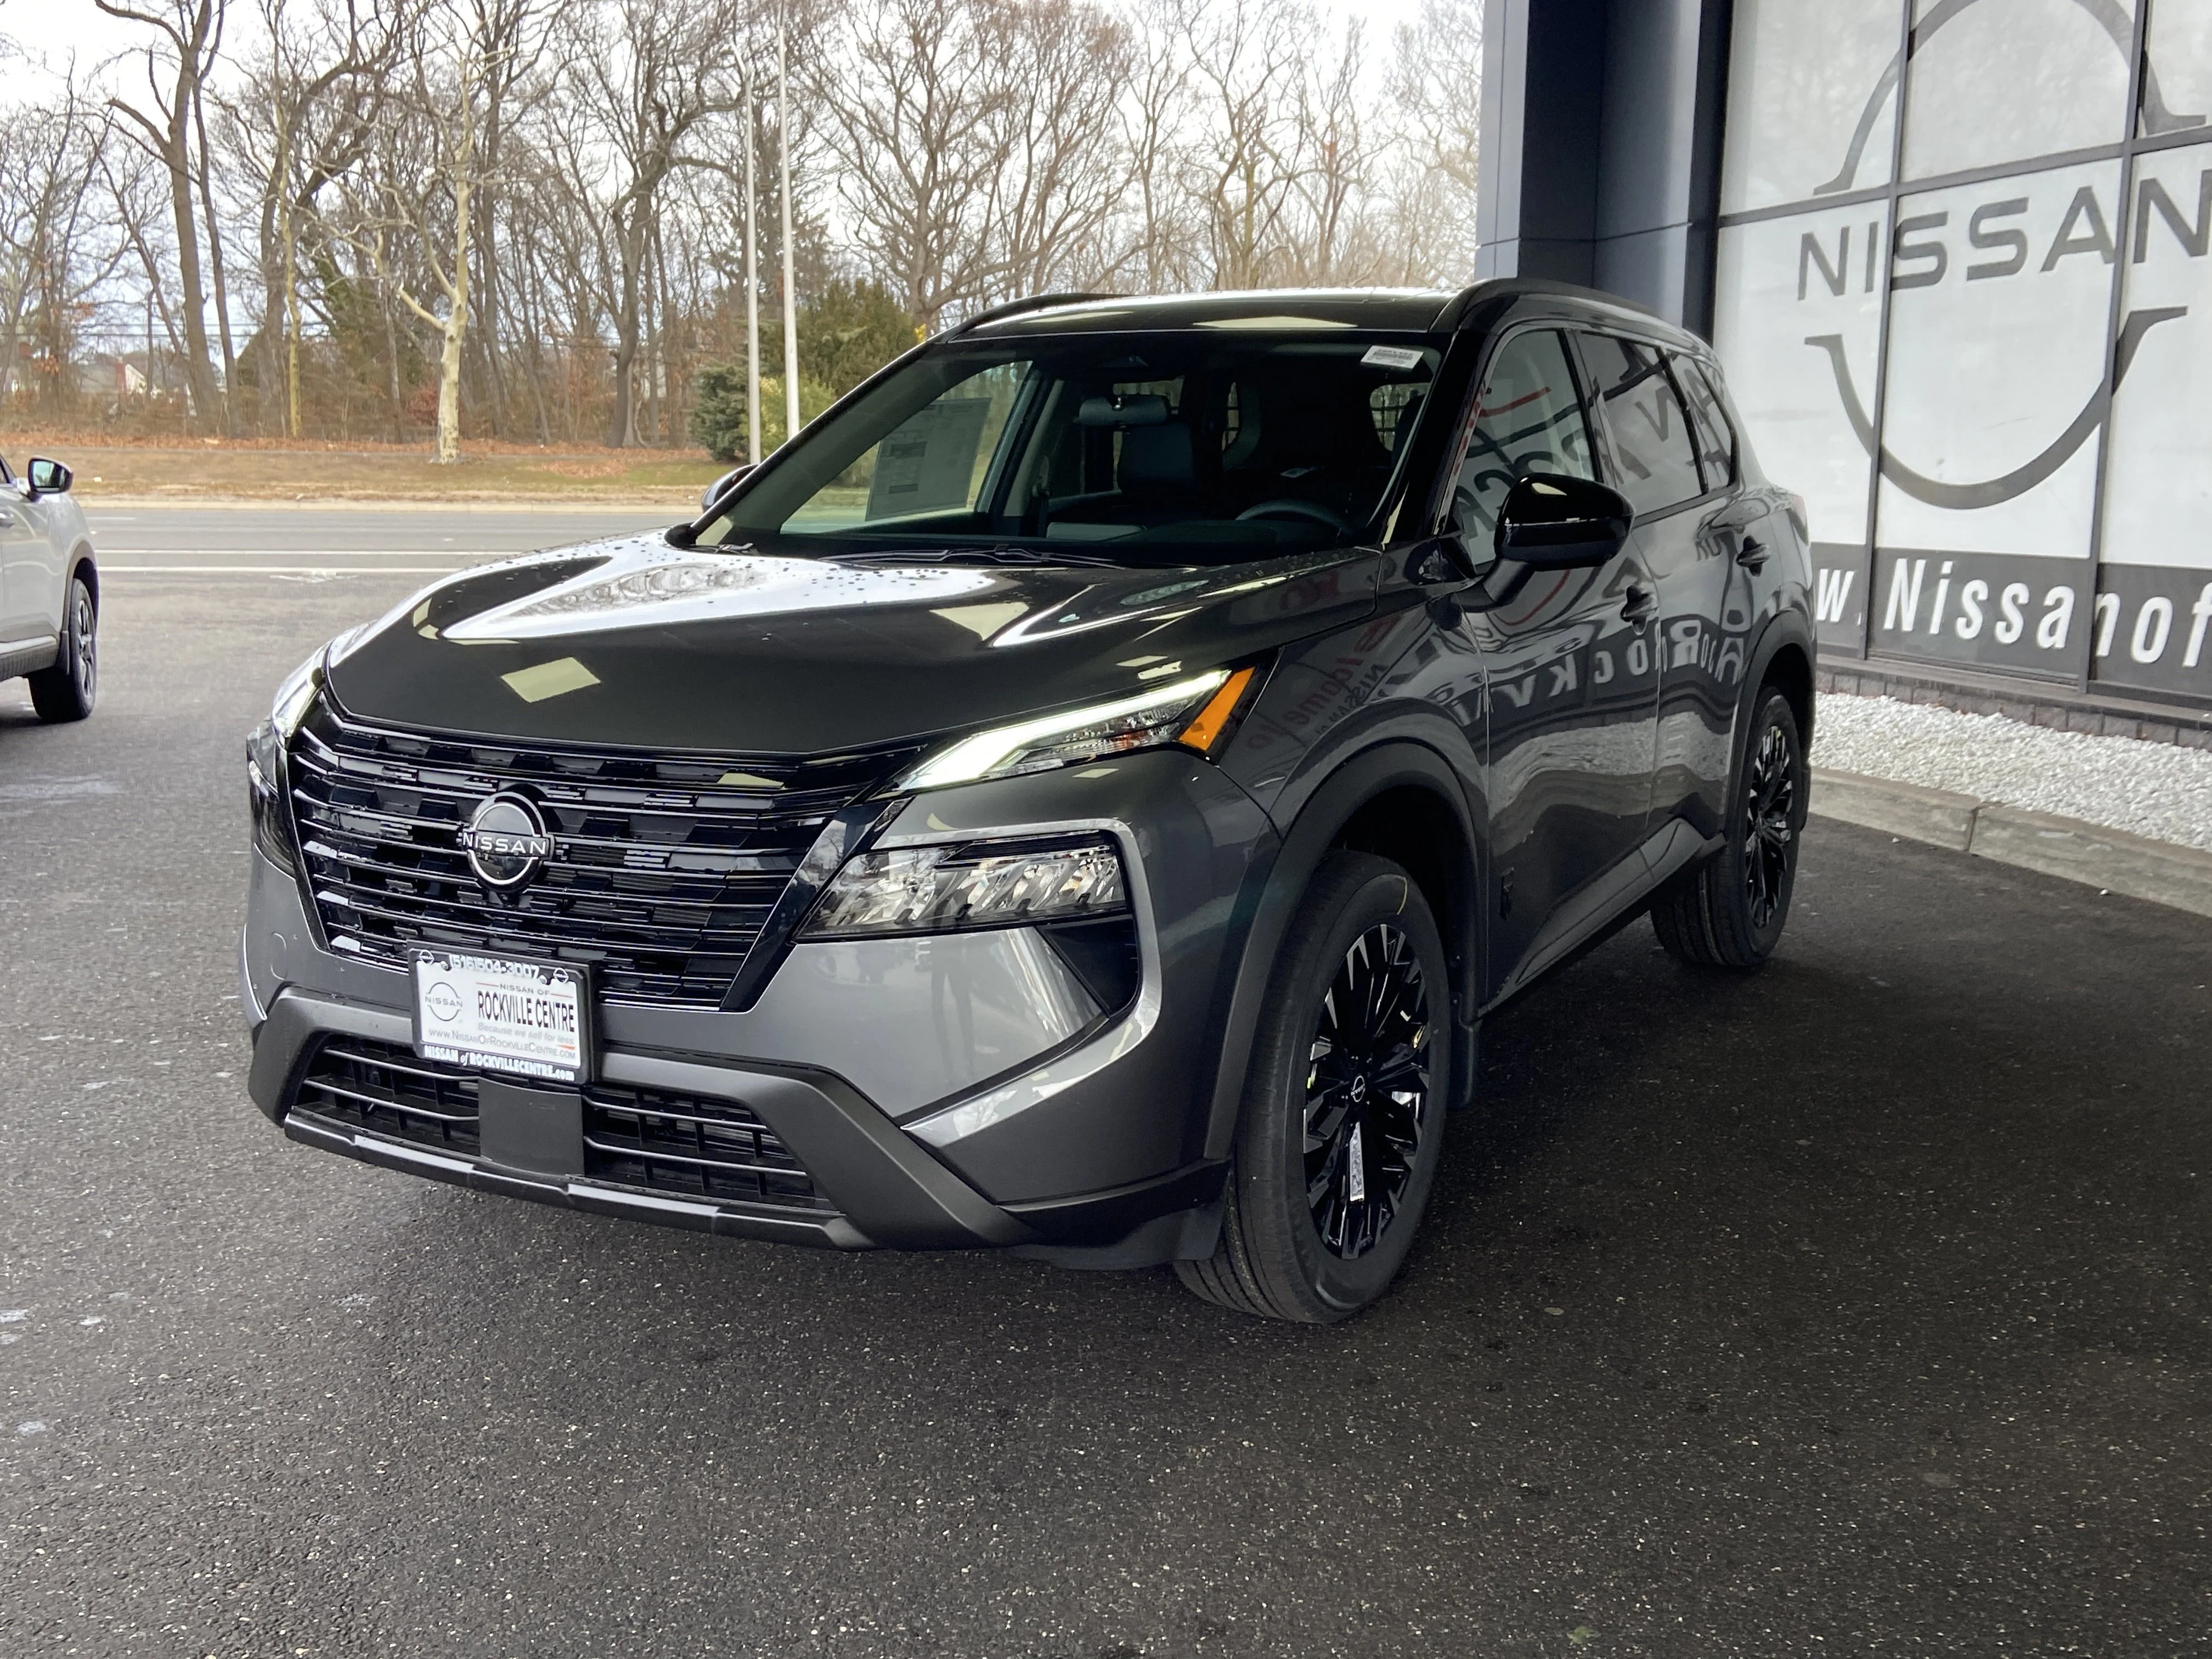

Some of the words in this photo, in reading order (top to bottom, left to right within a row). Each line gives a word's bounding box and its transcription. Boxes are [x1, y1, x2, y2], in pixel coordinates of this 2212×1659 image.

[1797, 168, 2212, 301] NISSAN
[462, 832, 546, 854] NISSAN
[500, 984, 534, 994] NISSAN
[425, 996, 463, 1008] NISSAN
[478, 990, 533, 1026] ROCKVILLE
[535, 998, 575, 1032] CENTRE
[478, 1022, 512, 1035] Because
[528, 1031, 543, 1040] sell
[544, 1032, 556, 1042] for
[424, 1045, 459, 1063] NISSAN
[460, 1052, 470, 1066] of
